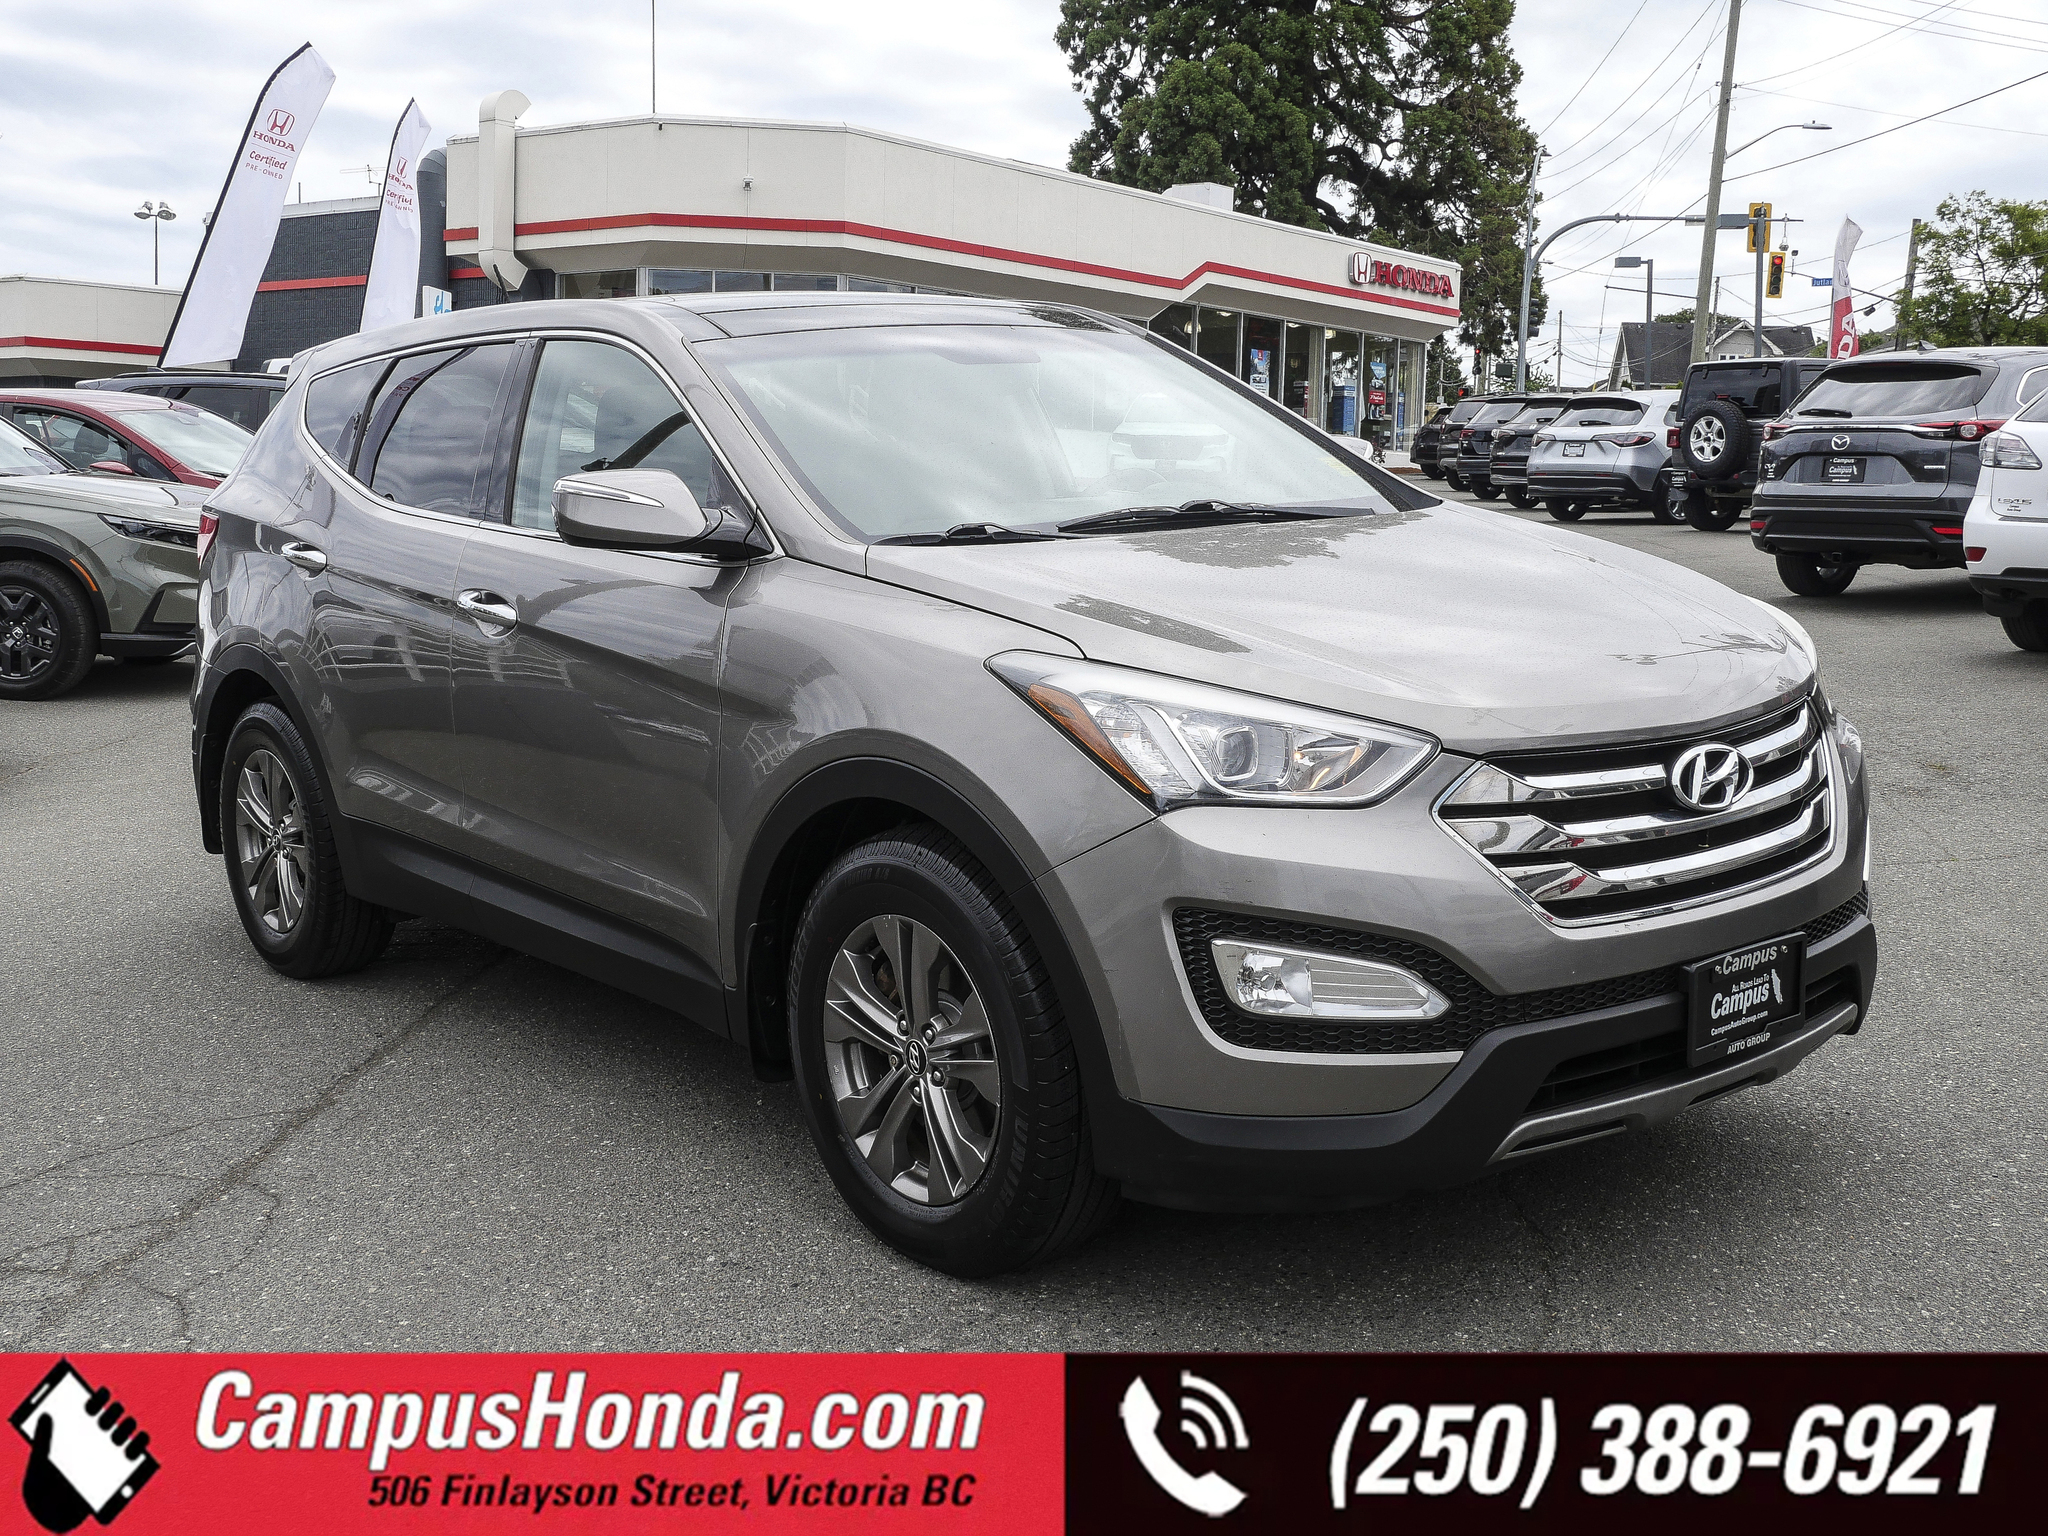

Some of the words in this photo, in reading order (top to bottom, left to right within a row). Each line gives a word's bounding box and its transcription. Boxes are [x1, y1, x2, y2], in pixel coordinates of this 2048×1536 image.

[253, 130, 296, 152] HONDA
[249, 150, 288, 170] Certified
[1374, 260, 1455, 298] HONDA
[1833, 457, 1855, 465] Campus
[1722, 946, 1778, 975] Campus
[1710, 982, 1770, 1020] Campus
[1710, 1010, 1769, 1037] CampusAutoGroup.com
[1727, 1041, 1746, 1055] AUTO
[1746, 1032, 1771, 1048] GROUP
